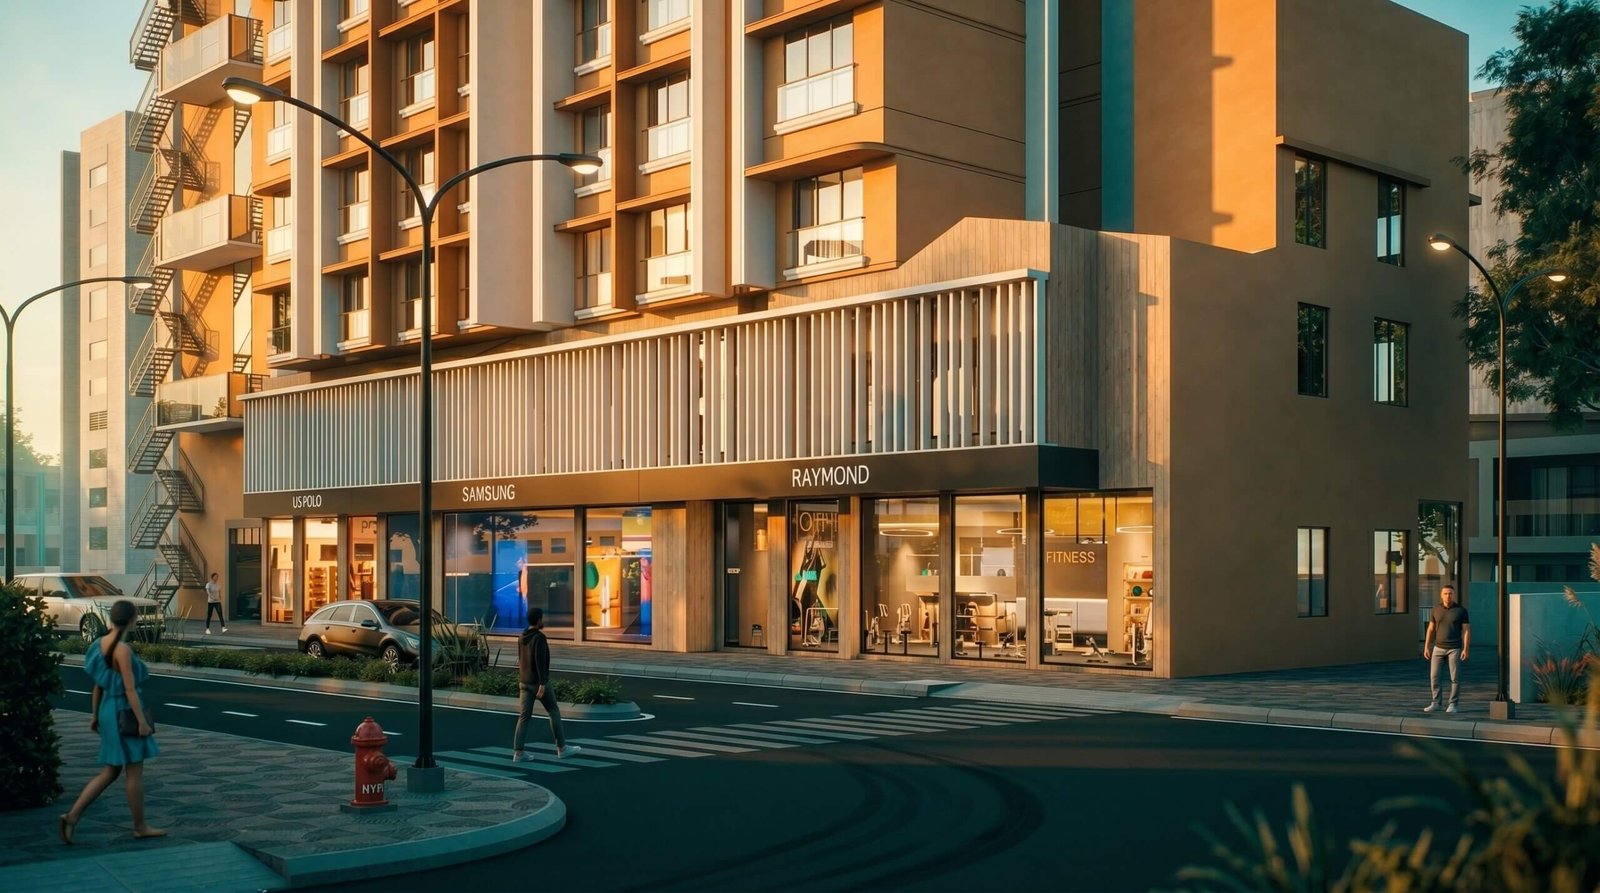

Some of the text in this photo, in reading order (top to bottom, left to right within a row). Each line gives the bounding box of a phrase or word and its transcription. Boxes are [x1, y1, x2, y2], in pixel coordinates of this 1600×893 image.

[792, 465, 870, 488] RAYMOND
[462, 484, 516, 502] SAMSUNG
[292, 494, 322, 509] US POLO
[1046, 551, 1096, 564] FITNESS
